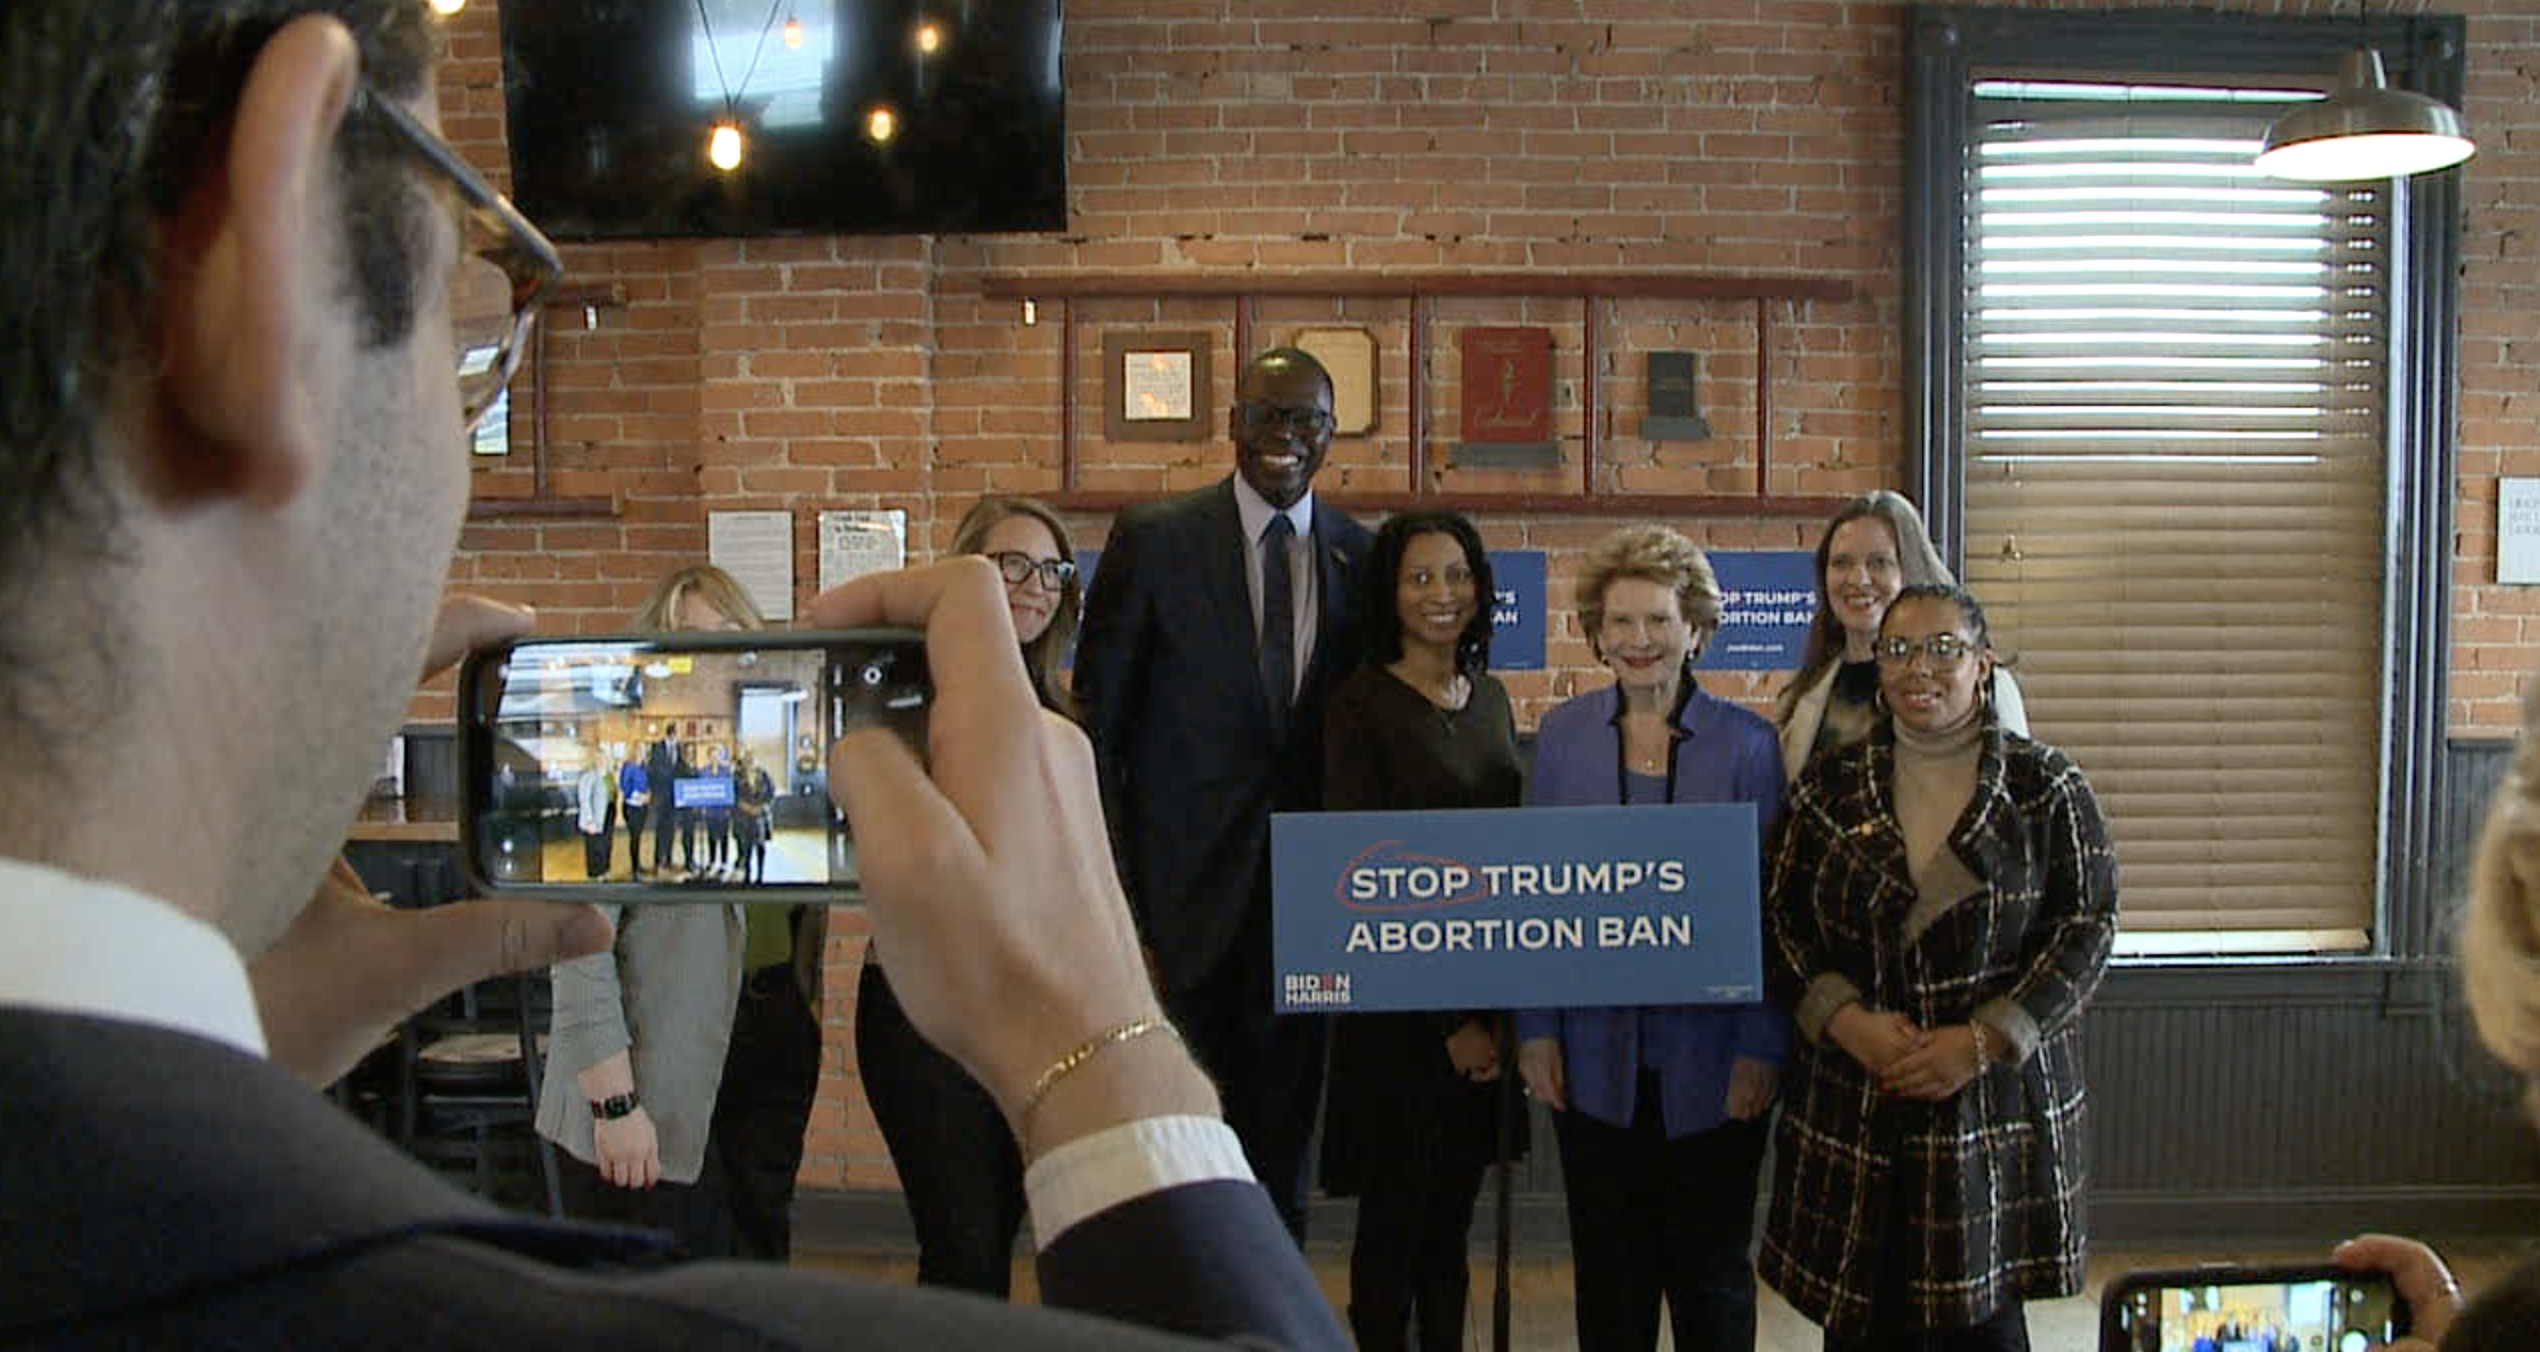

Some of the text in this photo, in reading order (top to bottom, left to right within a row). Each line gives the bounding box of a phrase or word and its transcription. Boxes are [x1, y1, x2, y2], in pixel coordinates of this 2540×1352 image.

[1718, 591, 1741, 605] OP
[1493, 611, 1519, 624] AN
[1718, 611, 1780, 625] ORTION
[1351, 860, 1686, 899] STOP TRUMP'S
[1345, 914, 1692, 953] ABORTION BAN
[1285, 989, 1351, 1005] HARRIS
